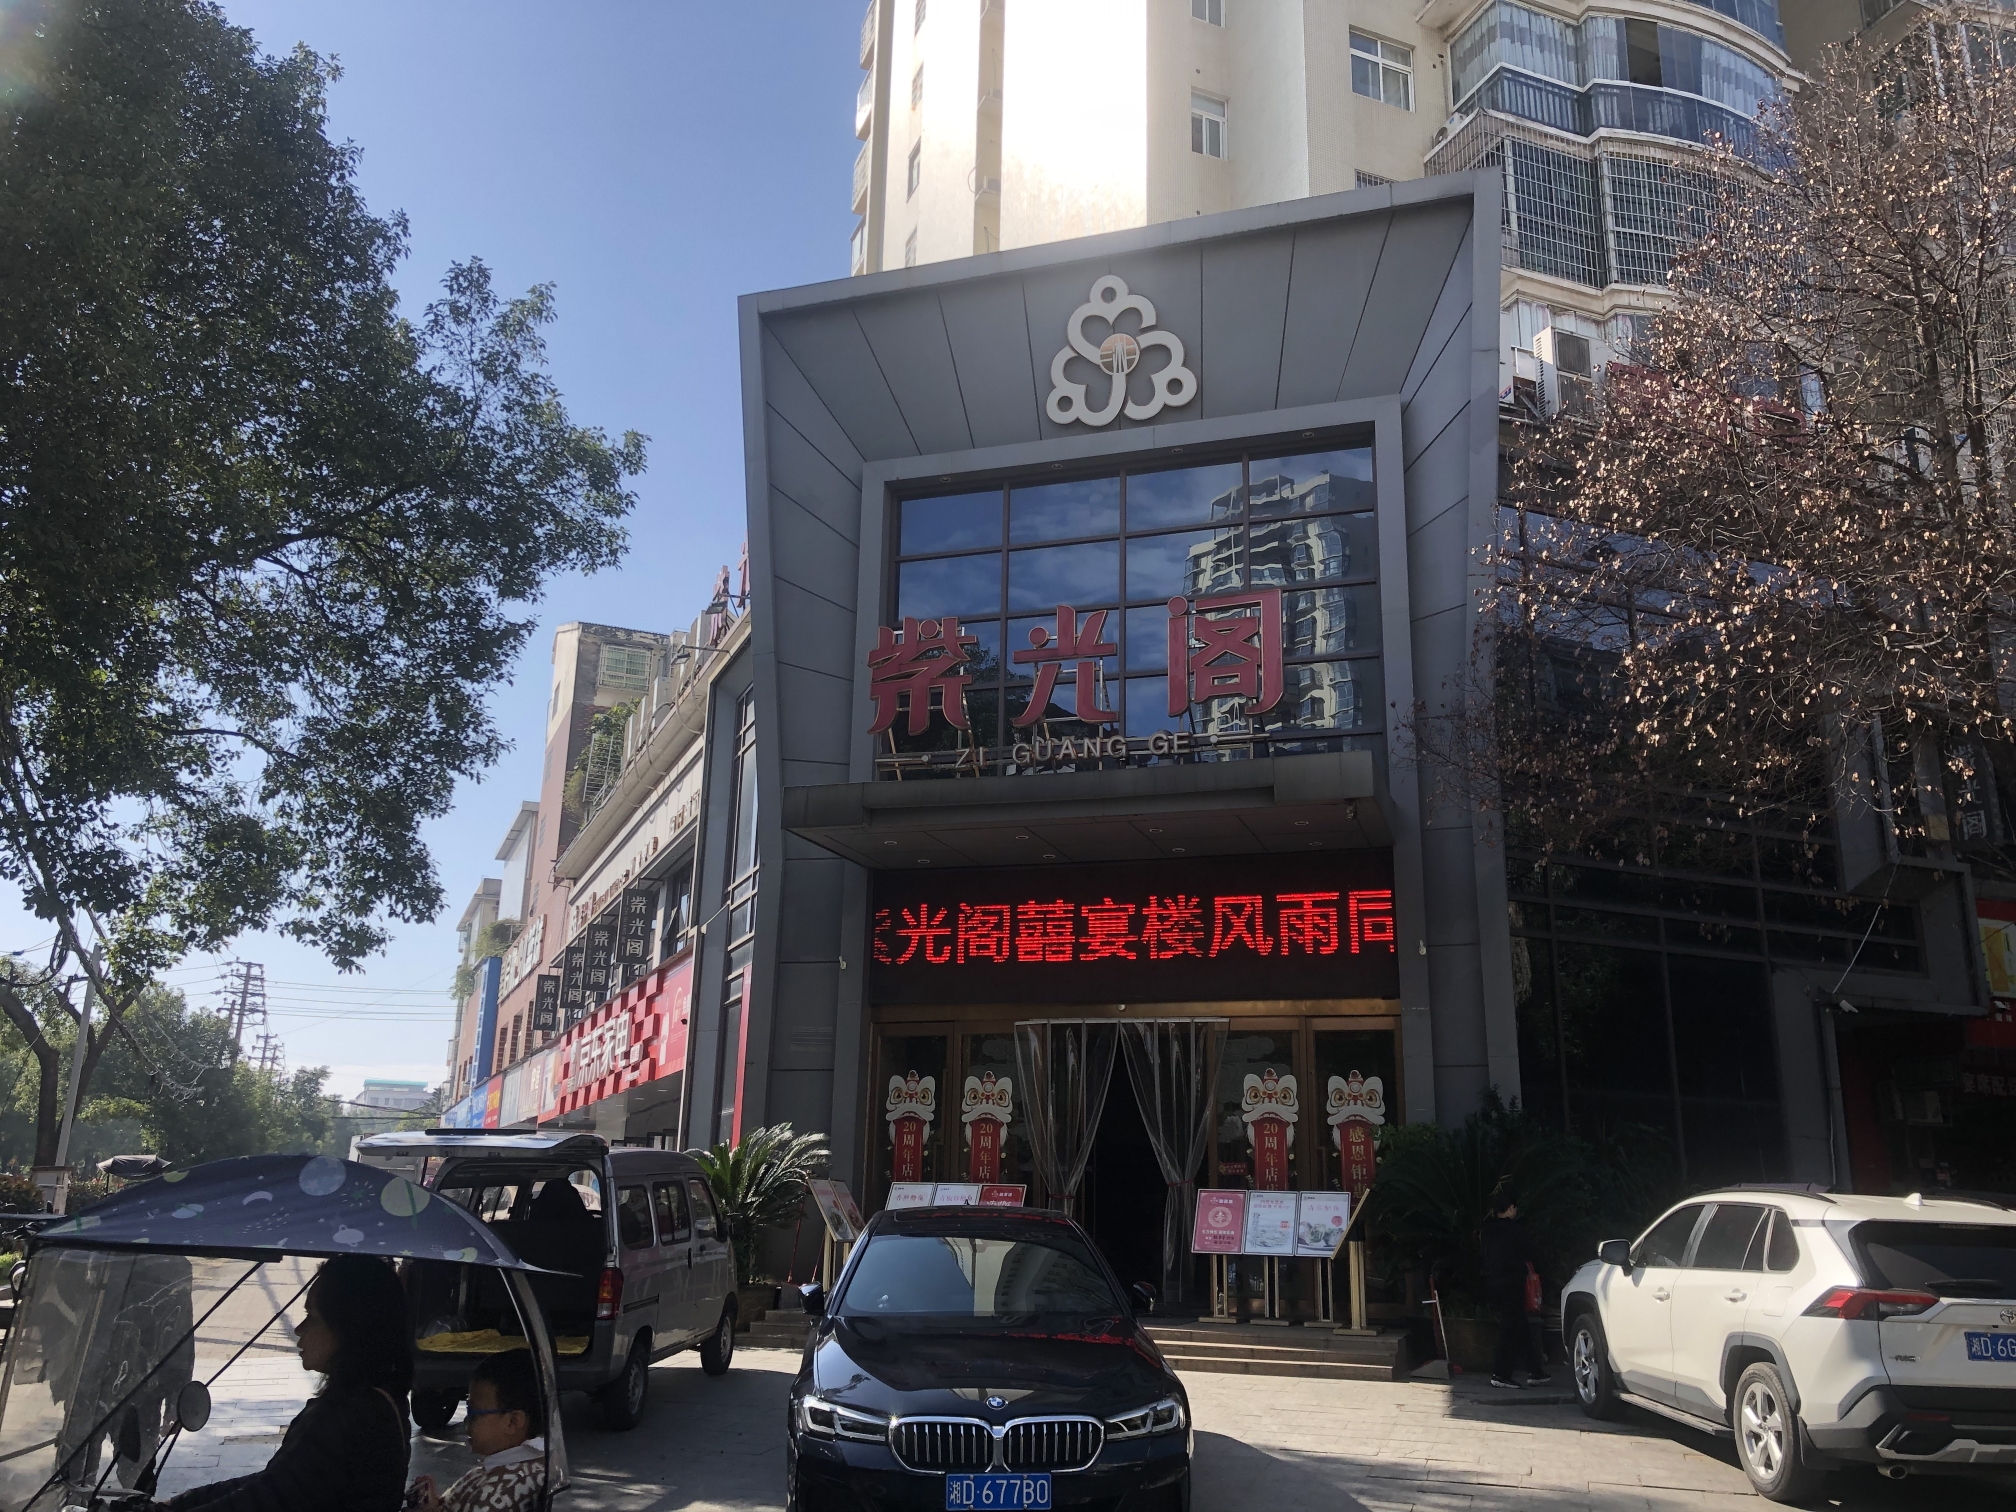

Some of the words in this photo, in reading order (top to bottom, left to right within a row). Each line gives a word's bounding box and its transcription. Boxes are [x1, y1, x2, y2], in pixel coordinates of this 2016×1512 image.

[868, 589, 1284, 736] 紫光阁
[954, 746, 987, 769] ZI
[1012, 735, 1128, 765] GUANG
[1148, 730, 1193, 755] GE
[577, 1009, 632, 1088] 京东家电
[901, 1121, 916, 1181] 20周年店
[978, 1123, 993, 1182] 20周年店
